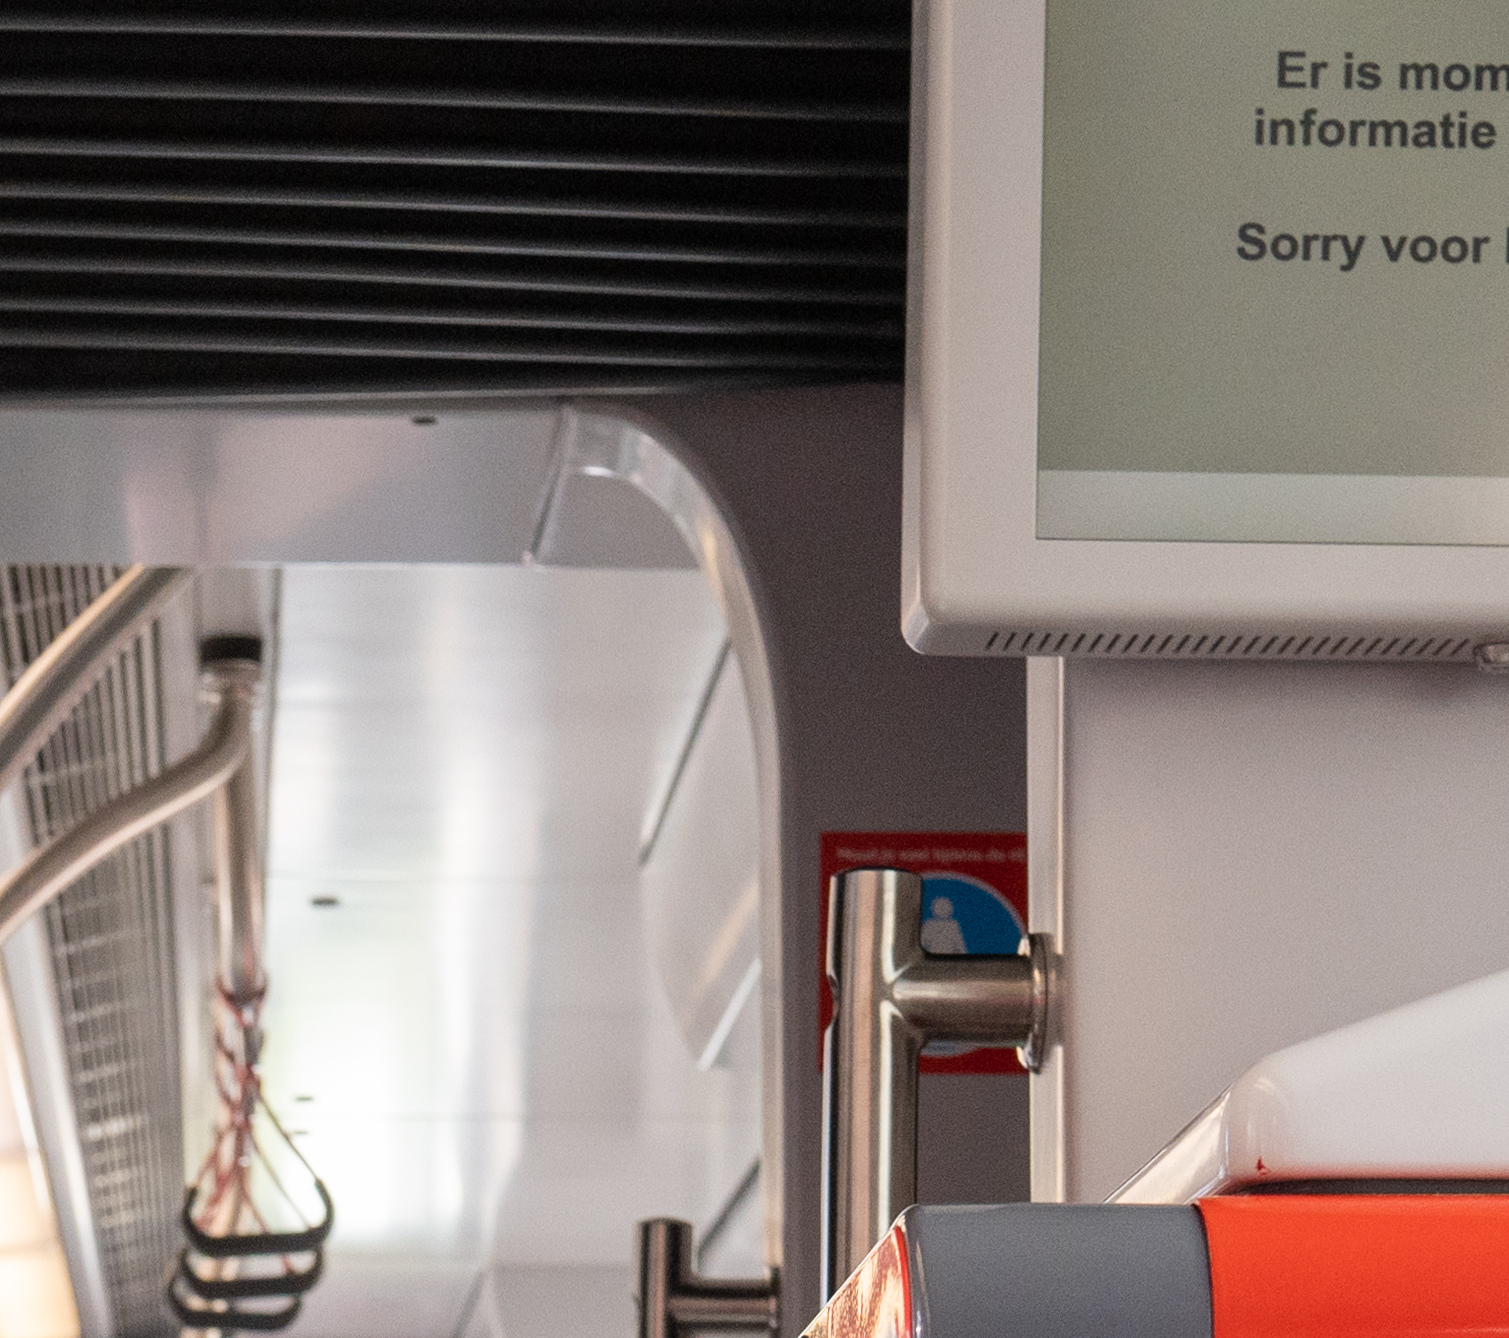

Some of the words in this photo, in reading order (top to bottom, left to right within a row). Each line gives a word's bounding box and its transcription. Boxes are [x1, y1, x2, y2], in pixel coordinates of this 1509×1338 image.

[1276, 50, 1328, 90] Er
[1343, 51, 1382, 91] is
[1254, 107, 1496, 149] informatie
[1236, 222, 1366, 272] Sorry
[1380, 234, 1490, 264] voor
